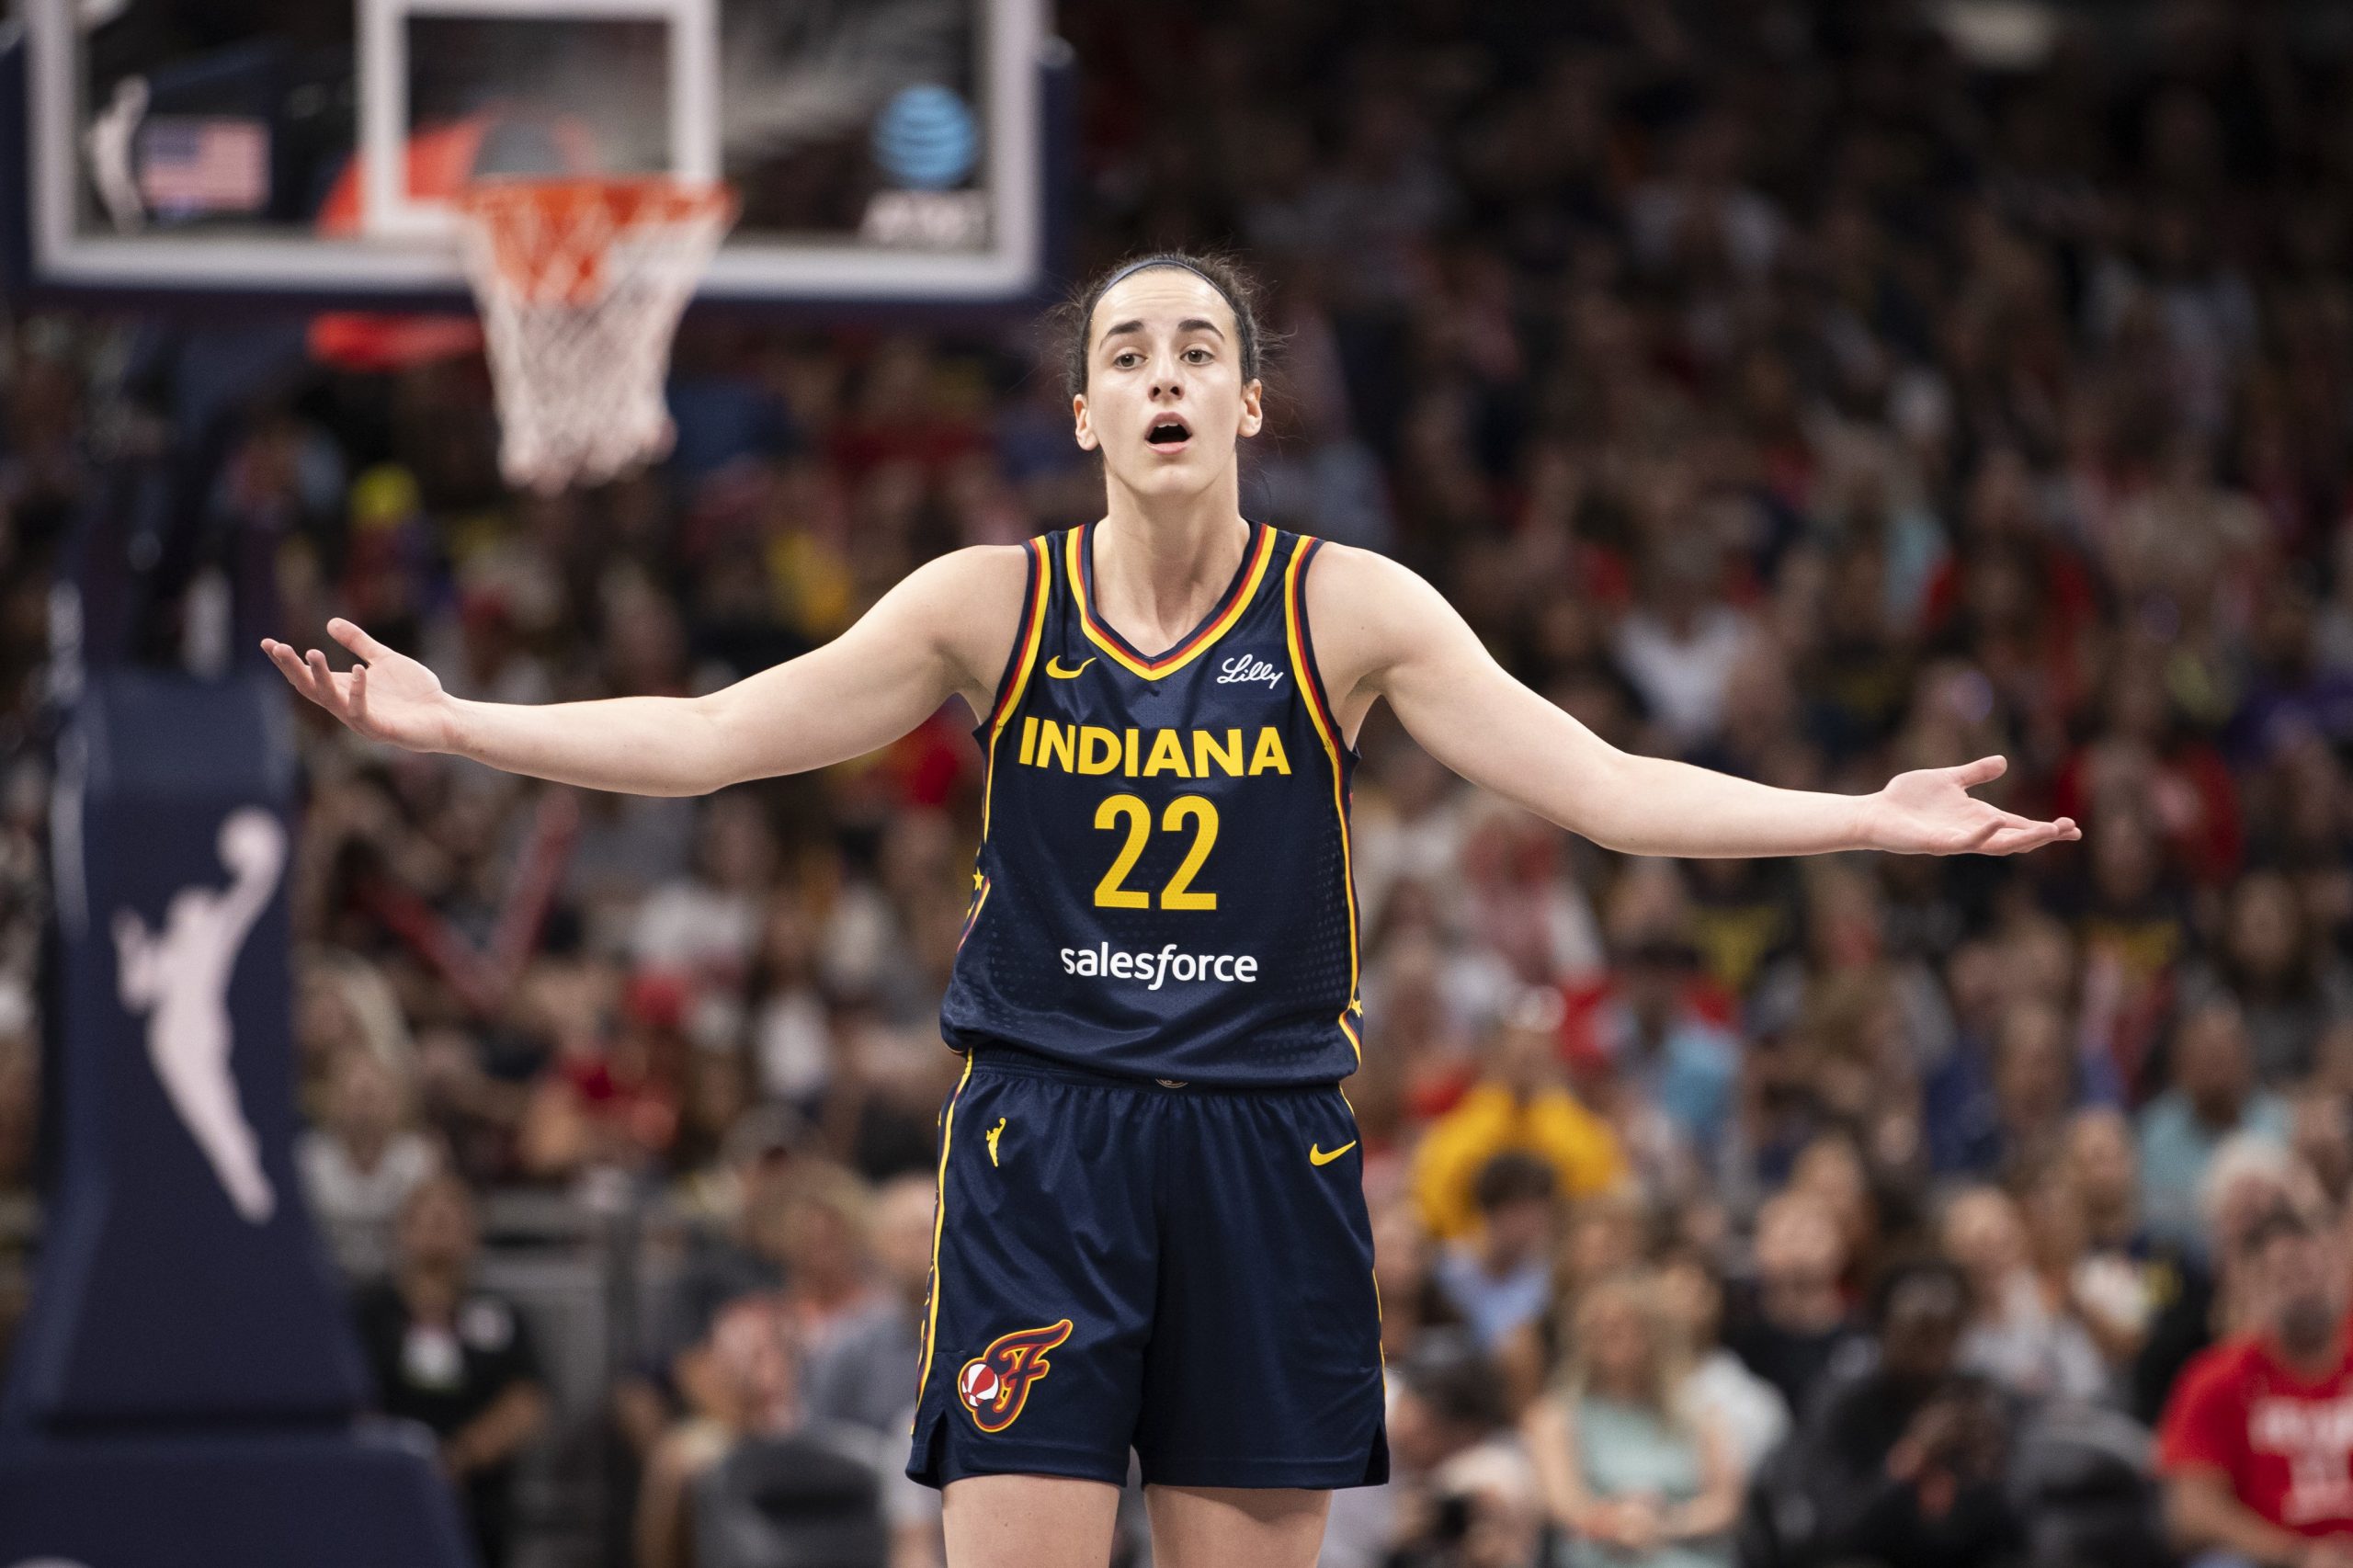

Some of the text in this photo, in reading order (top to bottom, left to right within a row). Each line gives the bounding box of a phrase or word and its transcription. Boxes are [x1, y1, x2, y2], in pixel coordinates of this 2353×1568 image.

[1216, 653, 1284, 689] Lilly
[1018, 716, 1292, 778] INDIANA
[1094, 793, 1220, 911] 22
[1060, 941, 1258, 991] salesforce
